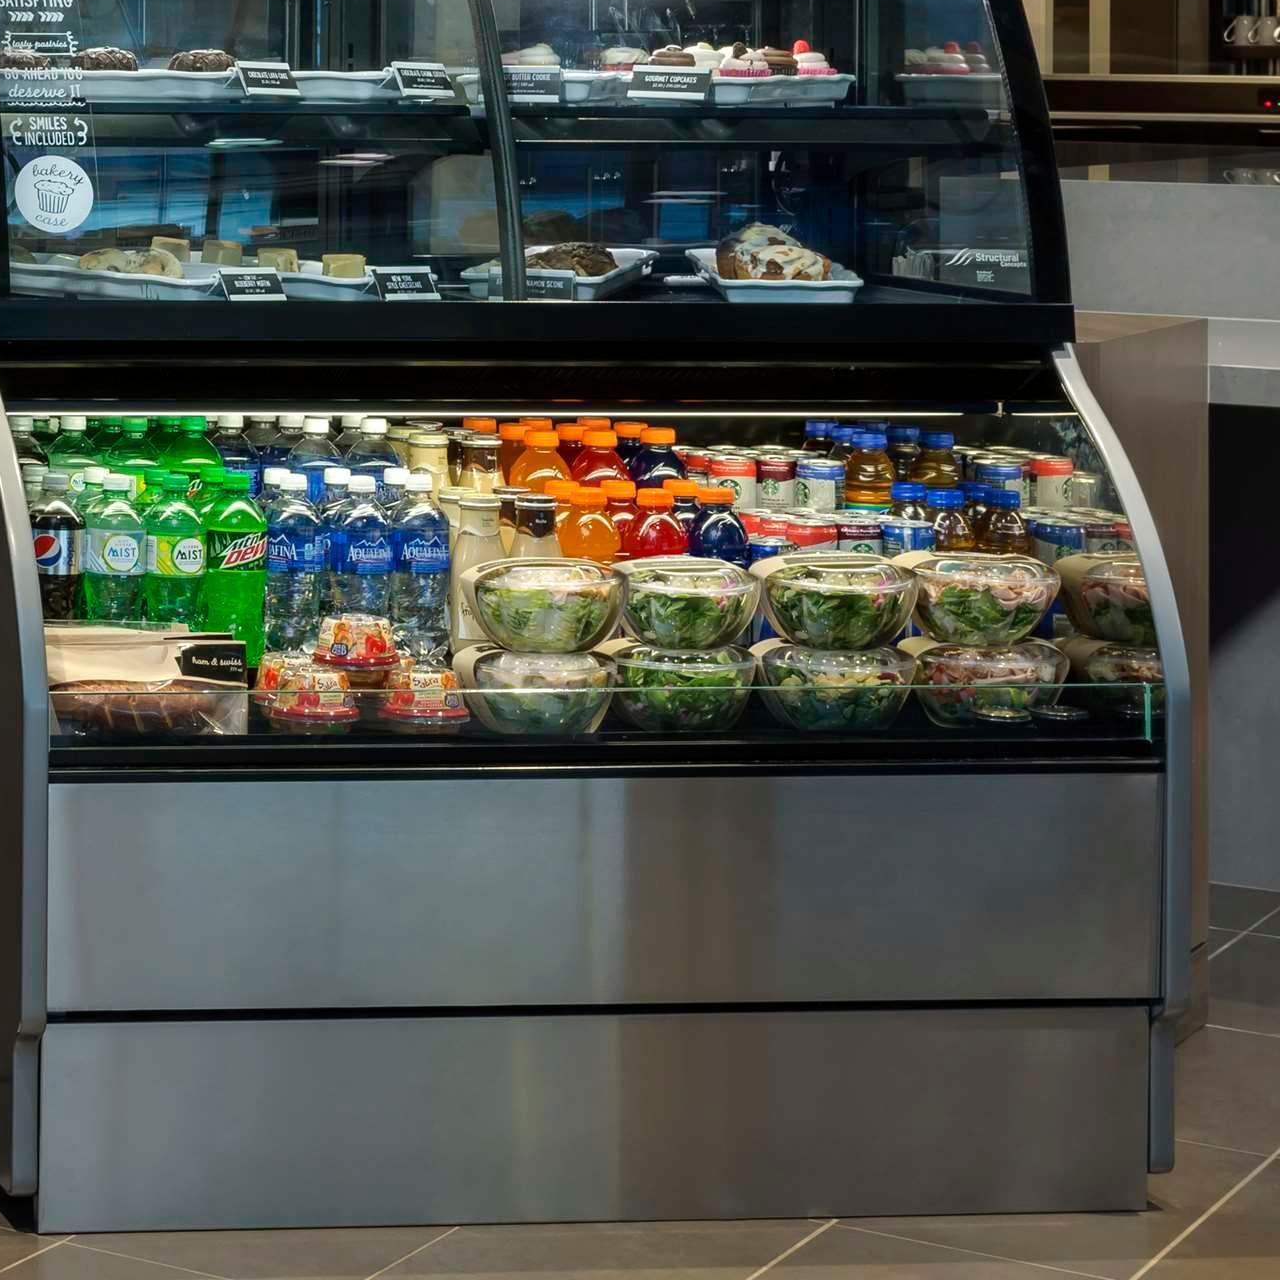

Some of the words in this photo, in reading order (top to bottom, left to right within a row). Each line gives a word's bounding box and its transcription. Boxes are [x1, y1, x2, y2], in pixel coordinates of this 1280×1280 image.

[22, 67, 58, 80] AHEAD
[60, 67, 83, 80] YOU
[8, 84, 67, 98] deserve
[70, 84, 81, 98] IT
[28, 116, 68, 131] SMILES
[24, 131, 75, 146] INCLUDED
[32, 164, 84, 187] bakery
[35, 214, 70, 227] case
[975, 252, 1019, 262] Structural
[107, 546, 136, 558] MIST
[175, 549, 202, 560] MIST
[269, 544, 297, 560] AFINA
[192, 656, 209, 665] ham
[211, 657, 218, 666] &
[220, 657, 242, 666] swiss
[412, 676, 440, 689] Sabra
